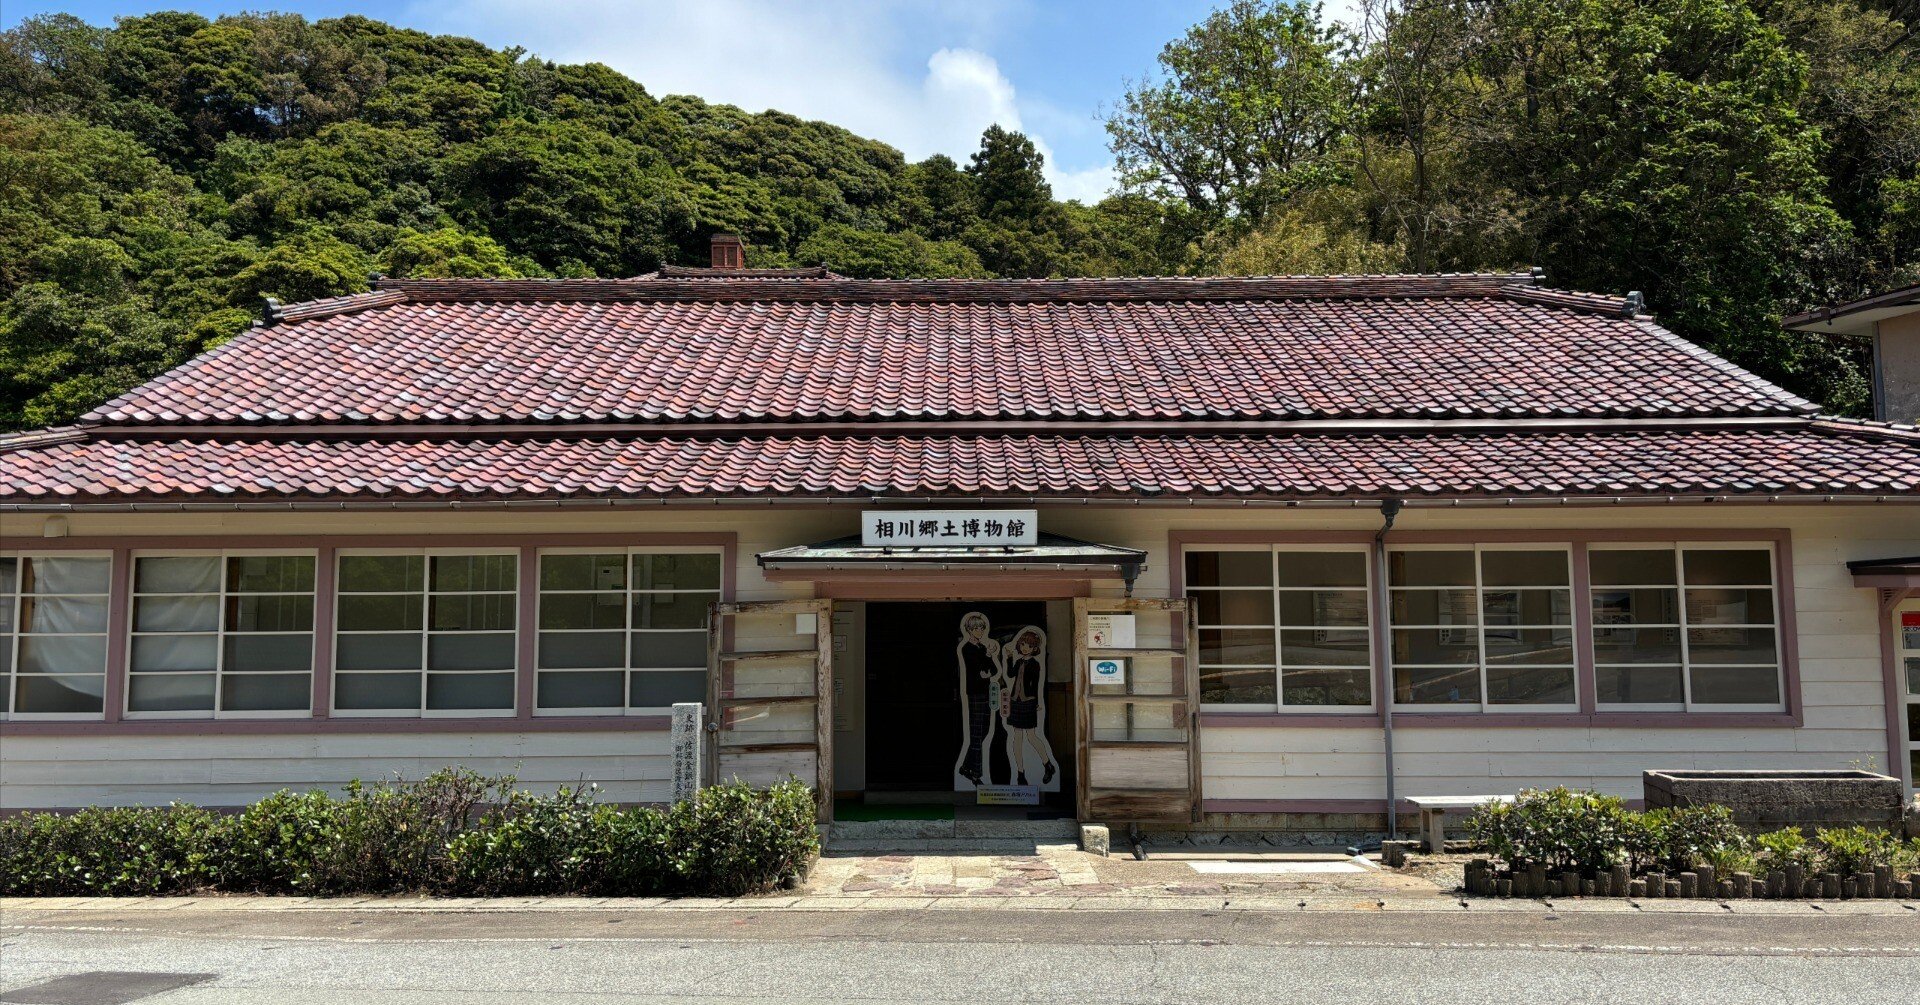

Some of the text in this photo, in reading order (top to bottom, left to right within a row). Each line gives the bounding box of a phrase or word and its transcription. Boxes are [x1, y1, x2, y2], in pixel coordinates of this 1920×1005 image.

[875, 518, 1026, 539] 相川郷土博物館
[1098, 665, 1116, 673] Wi-Fi
